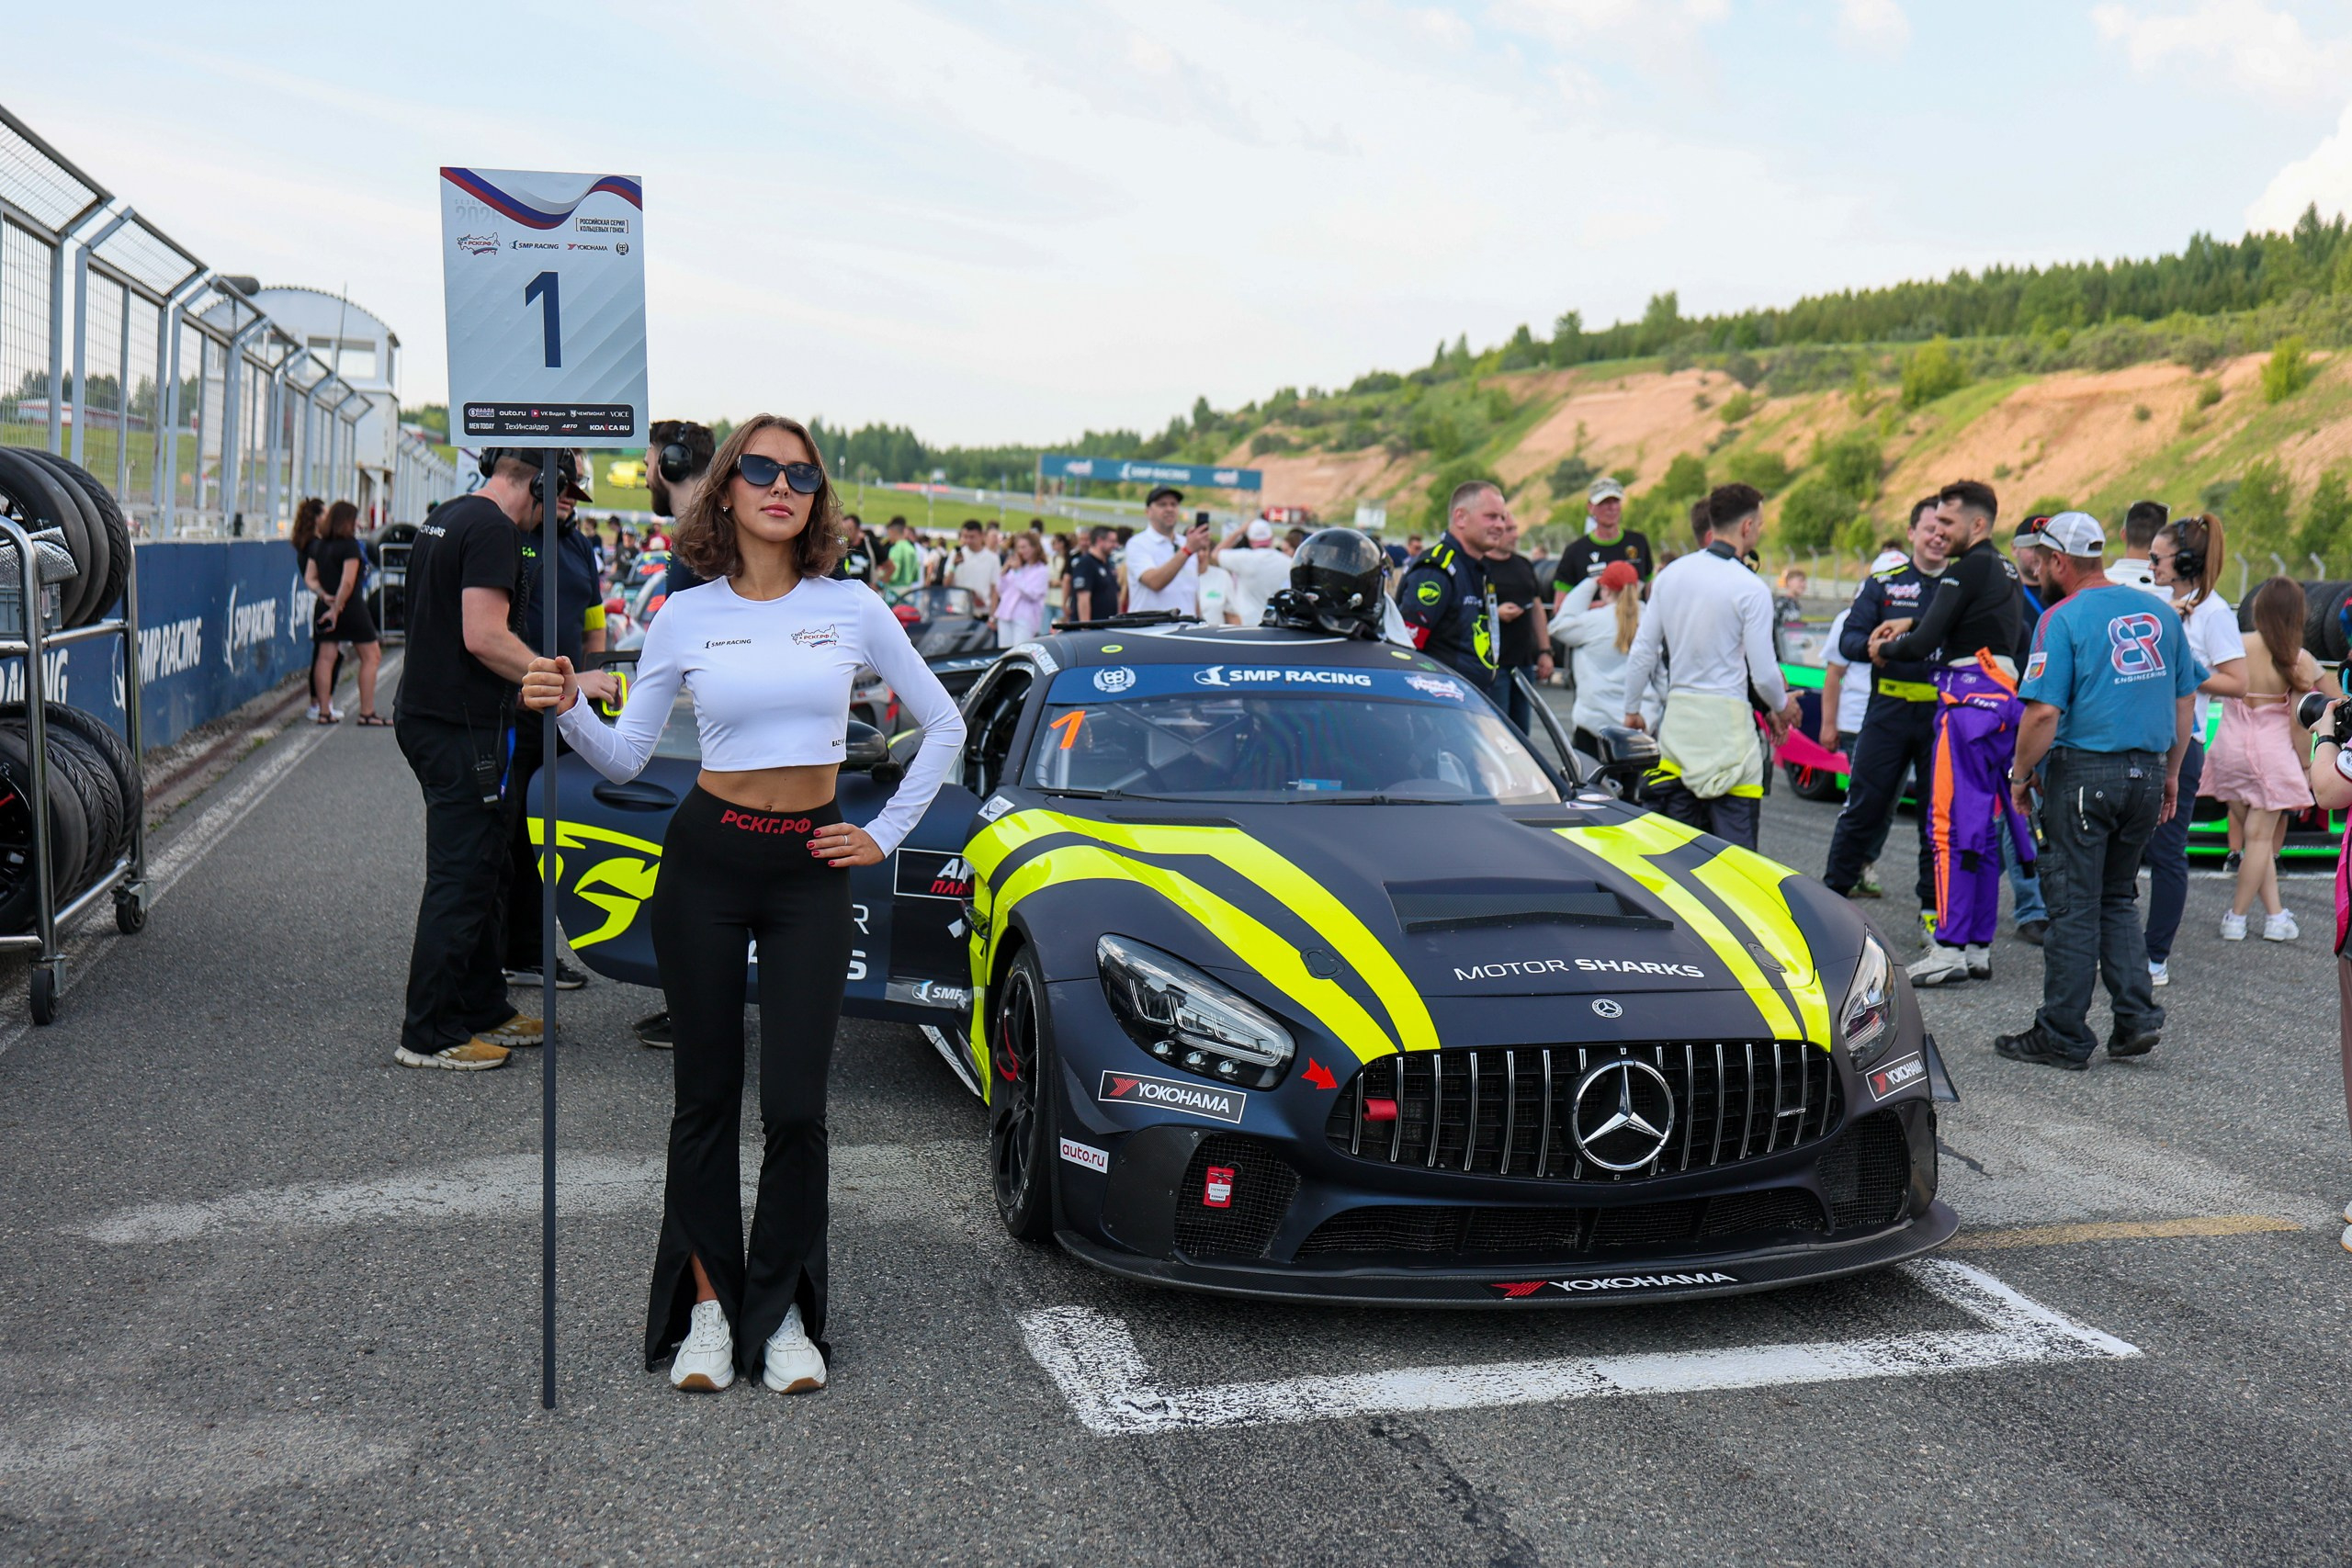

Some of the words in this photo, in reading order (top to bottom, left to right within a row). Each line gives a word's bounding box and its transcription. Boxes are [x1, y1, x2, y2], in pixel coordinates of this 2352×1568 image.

[579, 218, 610, 226] РОССИЙСКАЯ
[579, 225, 610, 233] КОЛЬЦЕВЫХ
[525, 271, 561, 367] 1
[504, 423, 549, 432] ТехИнсайдер
[160, 615, 202, 678] RACING
[1229, 670, 1281, 682] SMP
[1285, 670, 1372, 687] RACING
[2114, 670, 2167, 684] ENGINEERING
[1049, 710, 1086, 750] 1
[720, 809, 811, 834] РСКГ.РФ
[1453, 959, 1569, 981] MOTOR
[1574, 958, 1705, 978] SHARKS
[1885, 1058, 1924, 1086] YOKOHAMA
[1138, 1082, 1230, 1113] YOKOHAMA
[1062, 1143, 1105, 1168] auto.ru
[1548, 1272, 1738, 1292] YOKOHAMA
